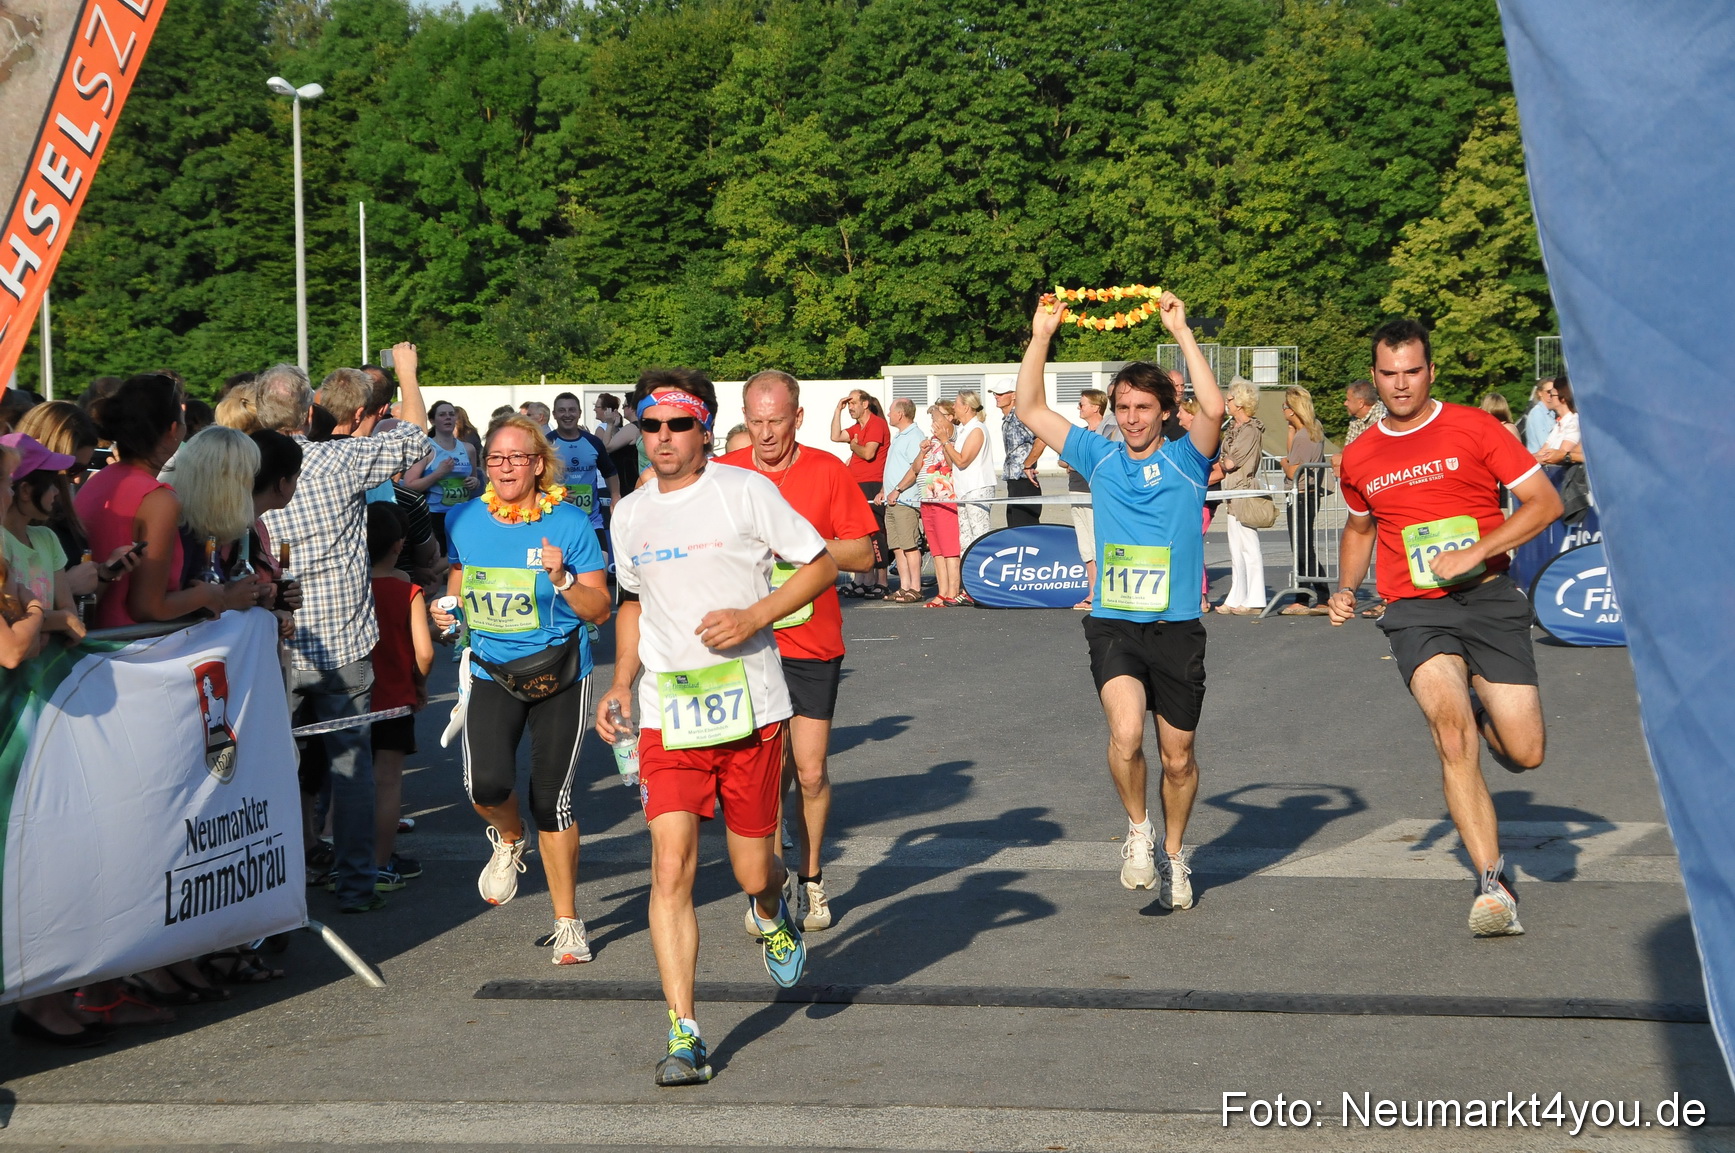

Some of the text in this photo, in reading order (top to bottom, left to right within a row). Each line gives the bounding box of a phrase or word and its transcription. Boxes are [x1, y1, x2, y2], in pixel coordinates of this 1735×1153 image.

[1366, 459, 1442, 496] NEUMARKT
[1409, 474, 1445, 486] STARKE STADT
[1009, 579, 1088, 592] AUTOMOBILE
[1106, 566, 1166, 595] 1177
[465, 590, 534, 617] 1173
[1596, 613, 1623, 623] AU
[522, 673, 557, 690] CAMEL
[664, 687, 744, 730] 1187
[184, 796, 269, 857] Neumarkter
[164, 838, 287, 927] Lammsbräu
